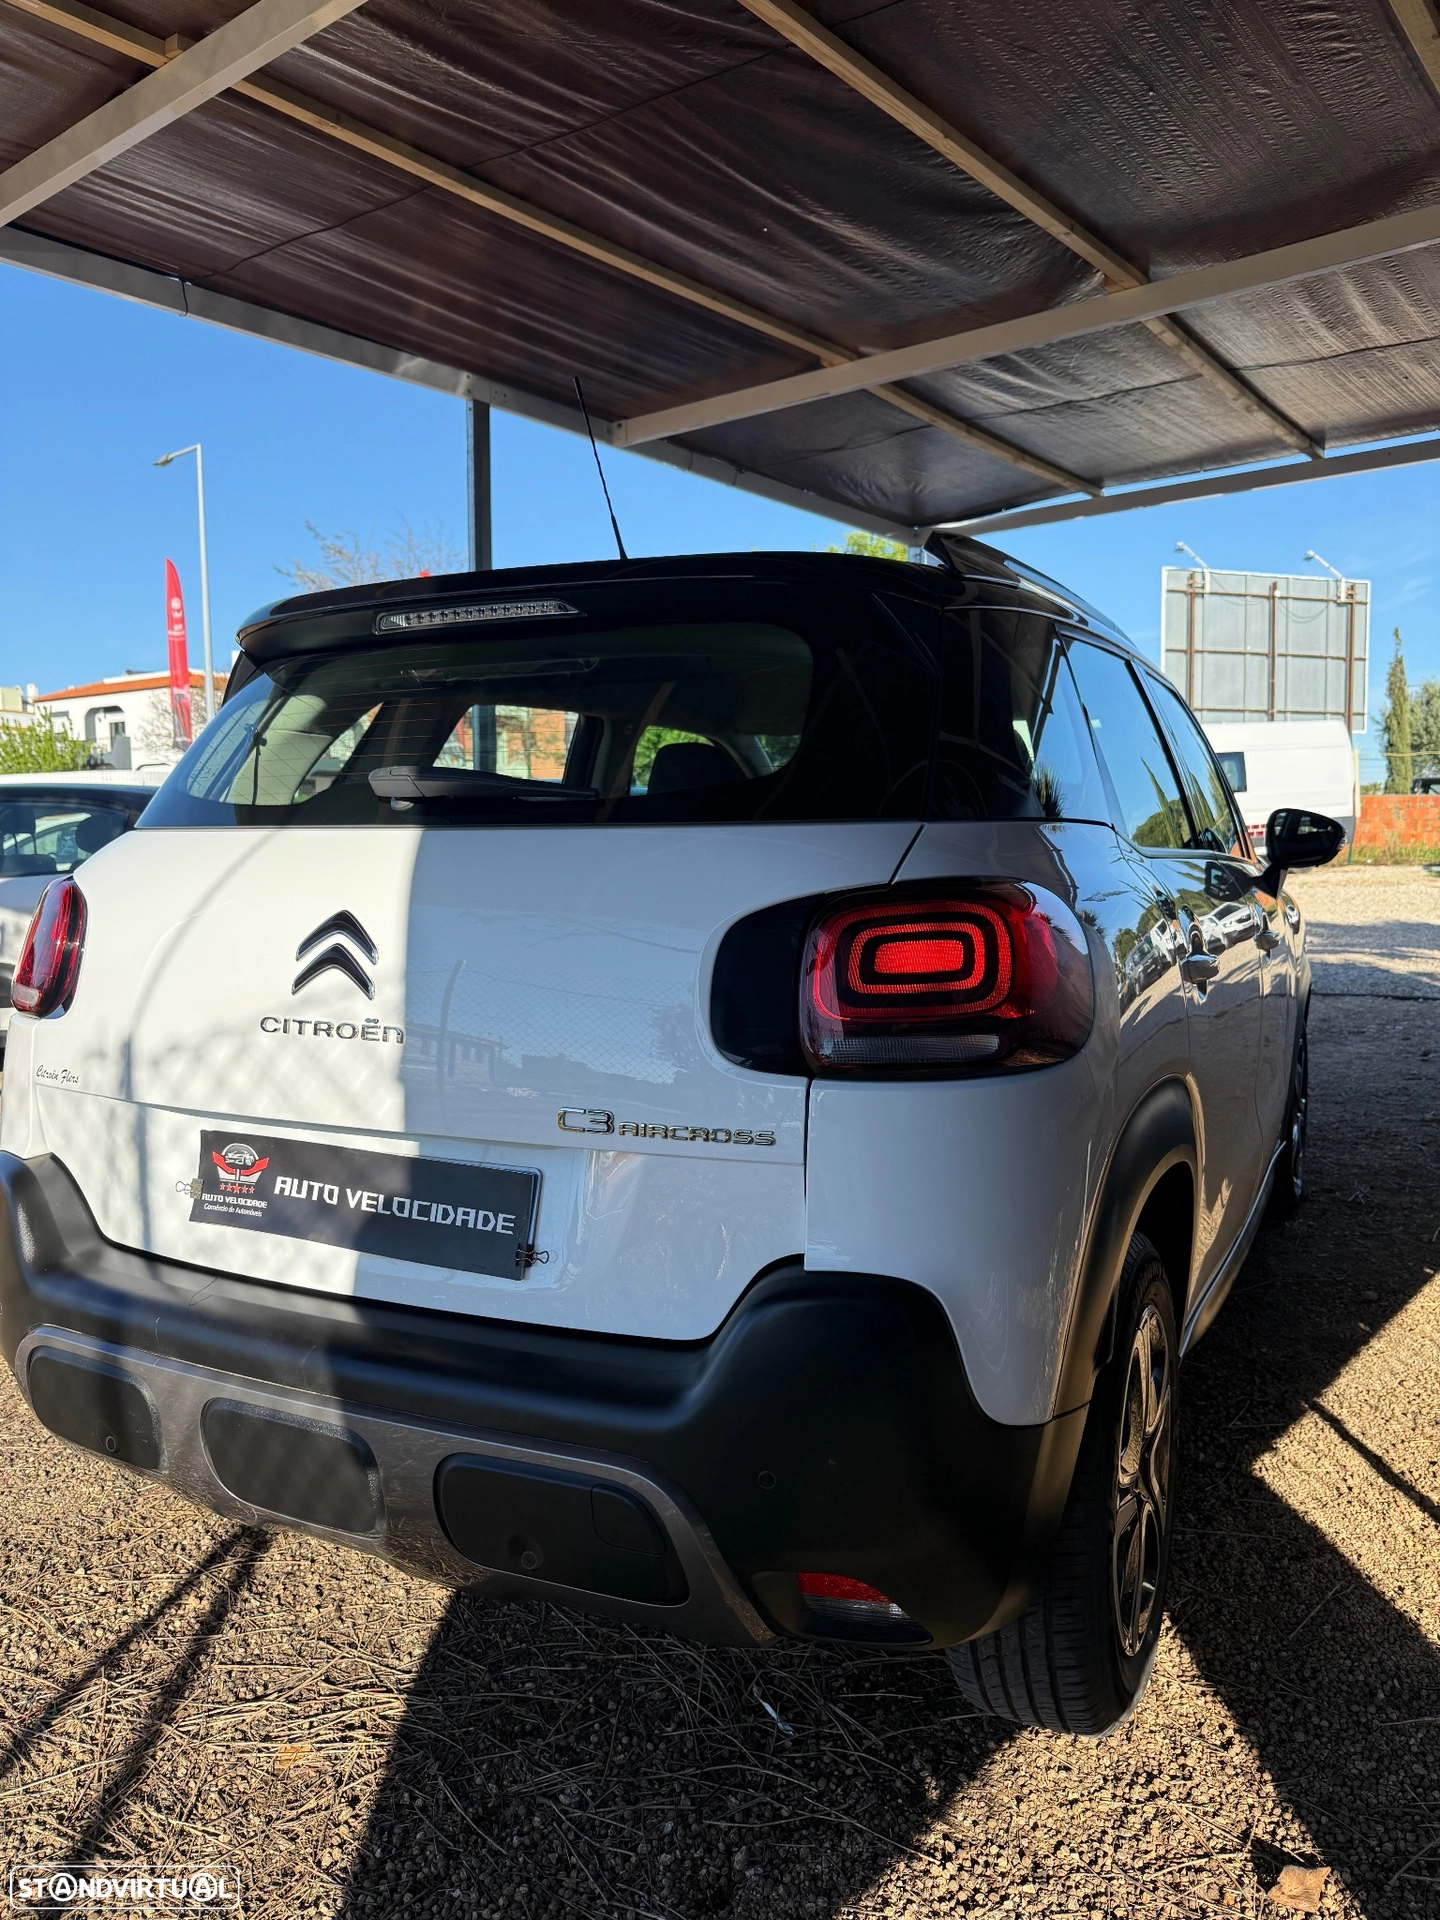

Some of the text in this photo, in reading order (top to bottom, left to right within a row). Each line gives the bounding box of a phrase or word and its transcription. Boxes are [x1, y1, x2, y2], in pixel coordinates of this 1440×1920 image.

[260, 1016, 404, 1044] CITROËN
[557, 1106, 777, 1146] C3 AIRCROSS
[202, 1193, 268, 1209] AUTO VELOCIDADE
[204, 1202, 228, 1212] Comércio
[235, 1207, 263, 1217] Automóveis
[273, 1176, 517, 1235] AUTO VELOCIDADE
